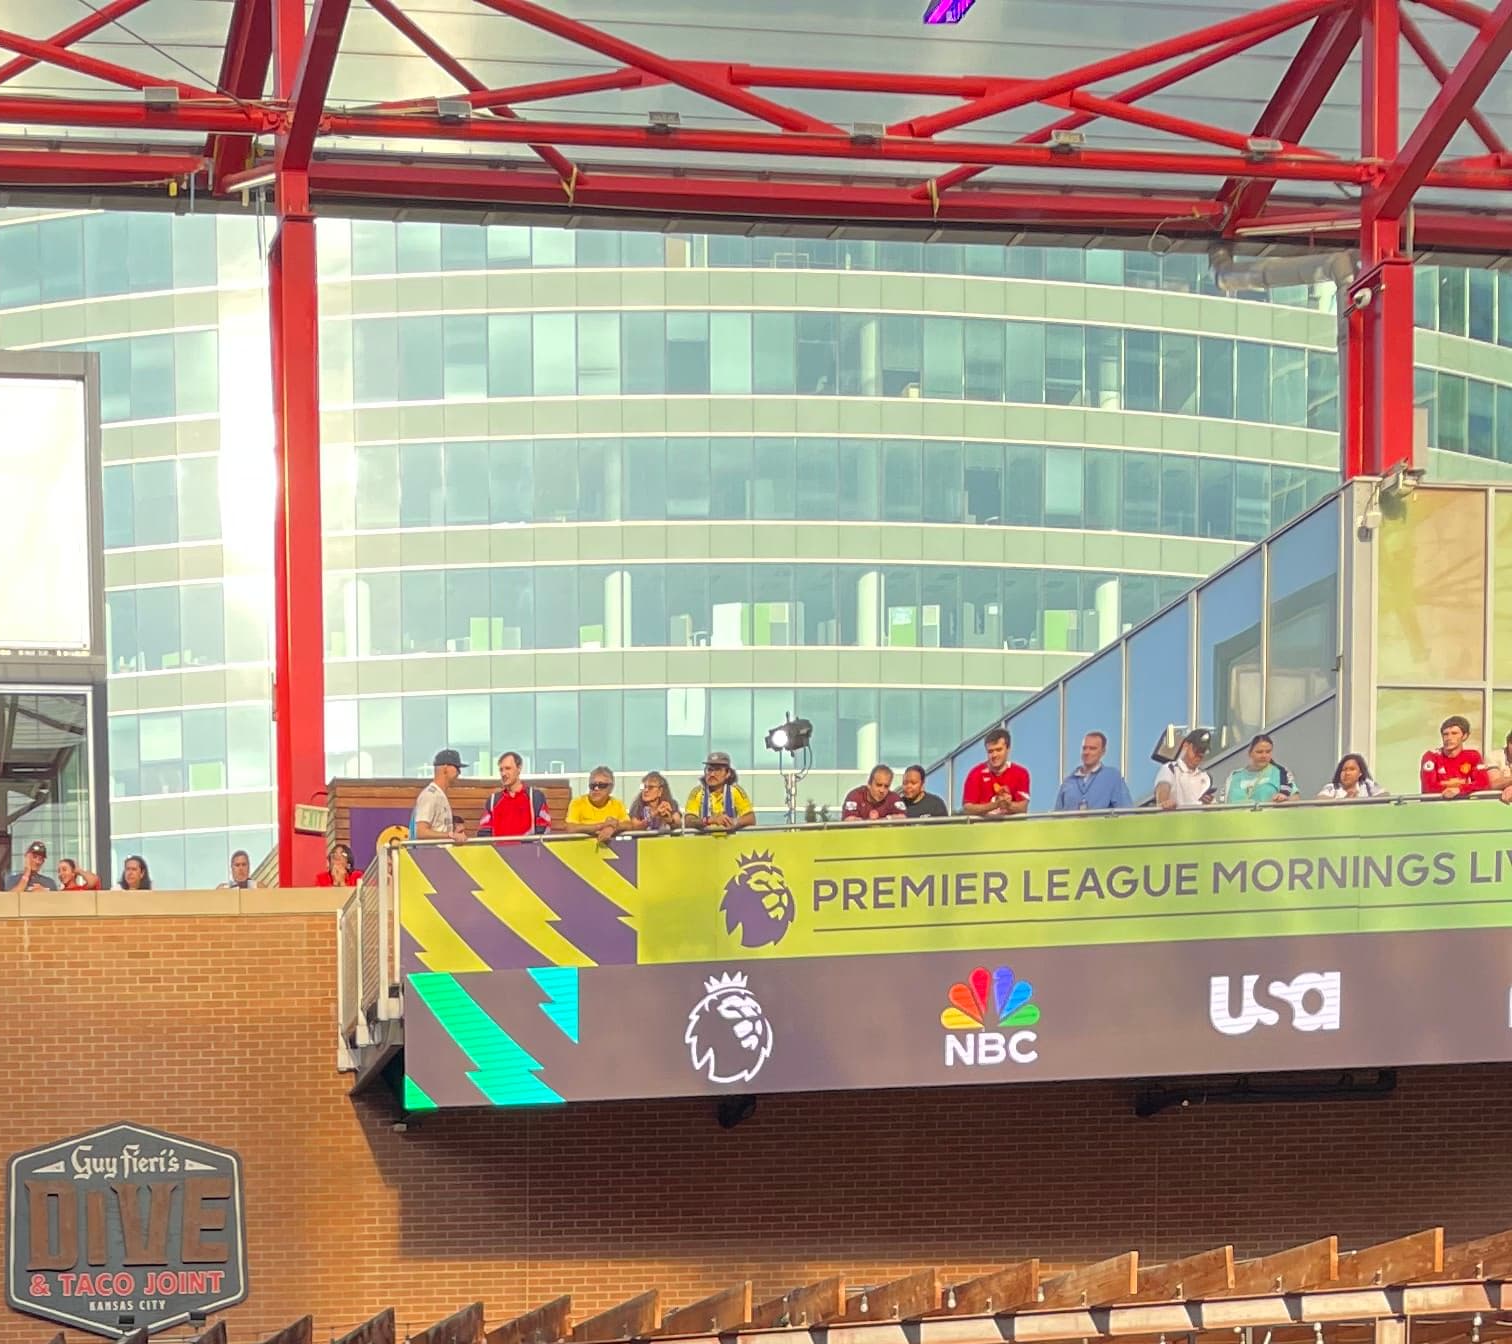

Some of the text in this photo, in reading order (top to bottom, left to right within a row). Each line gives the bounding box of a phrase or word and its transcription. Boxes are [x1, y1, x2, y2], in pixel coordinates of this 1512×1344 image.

[812, 850, 1512, 911] PREMIER LEAGUE MORNINGS LI
[944, 1031, 1038, 1067] NBC
[71, 1145, 117, 1180] Guy
[29, 1270, 225, 1297] & TACO JOINT
[89, 1300, 166, 1312] KANSAS CITY
